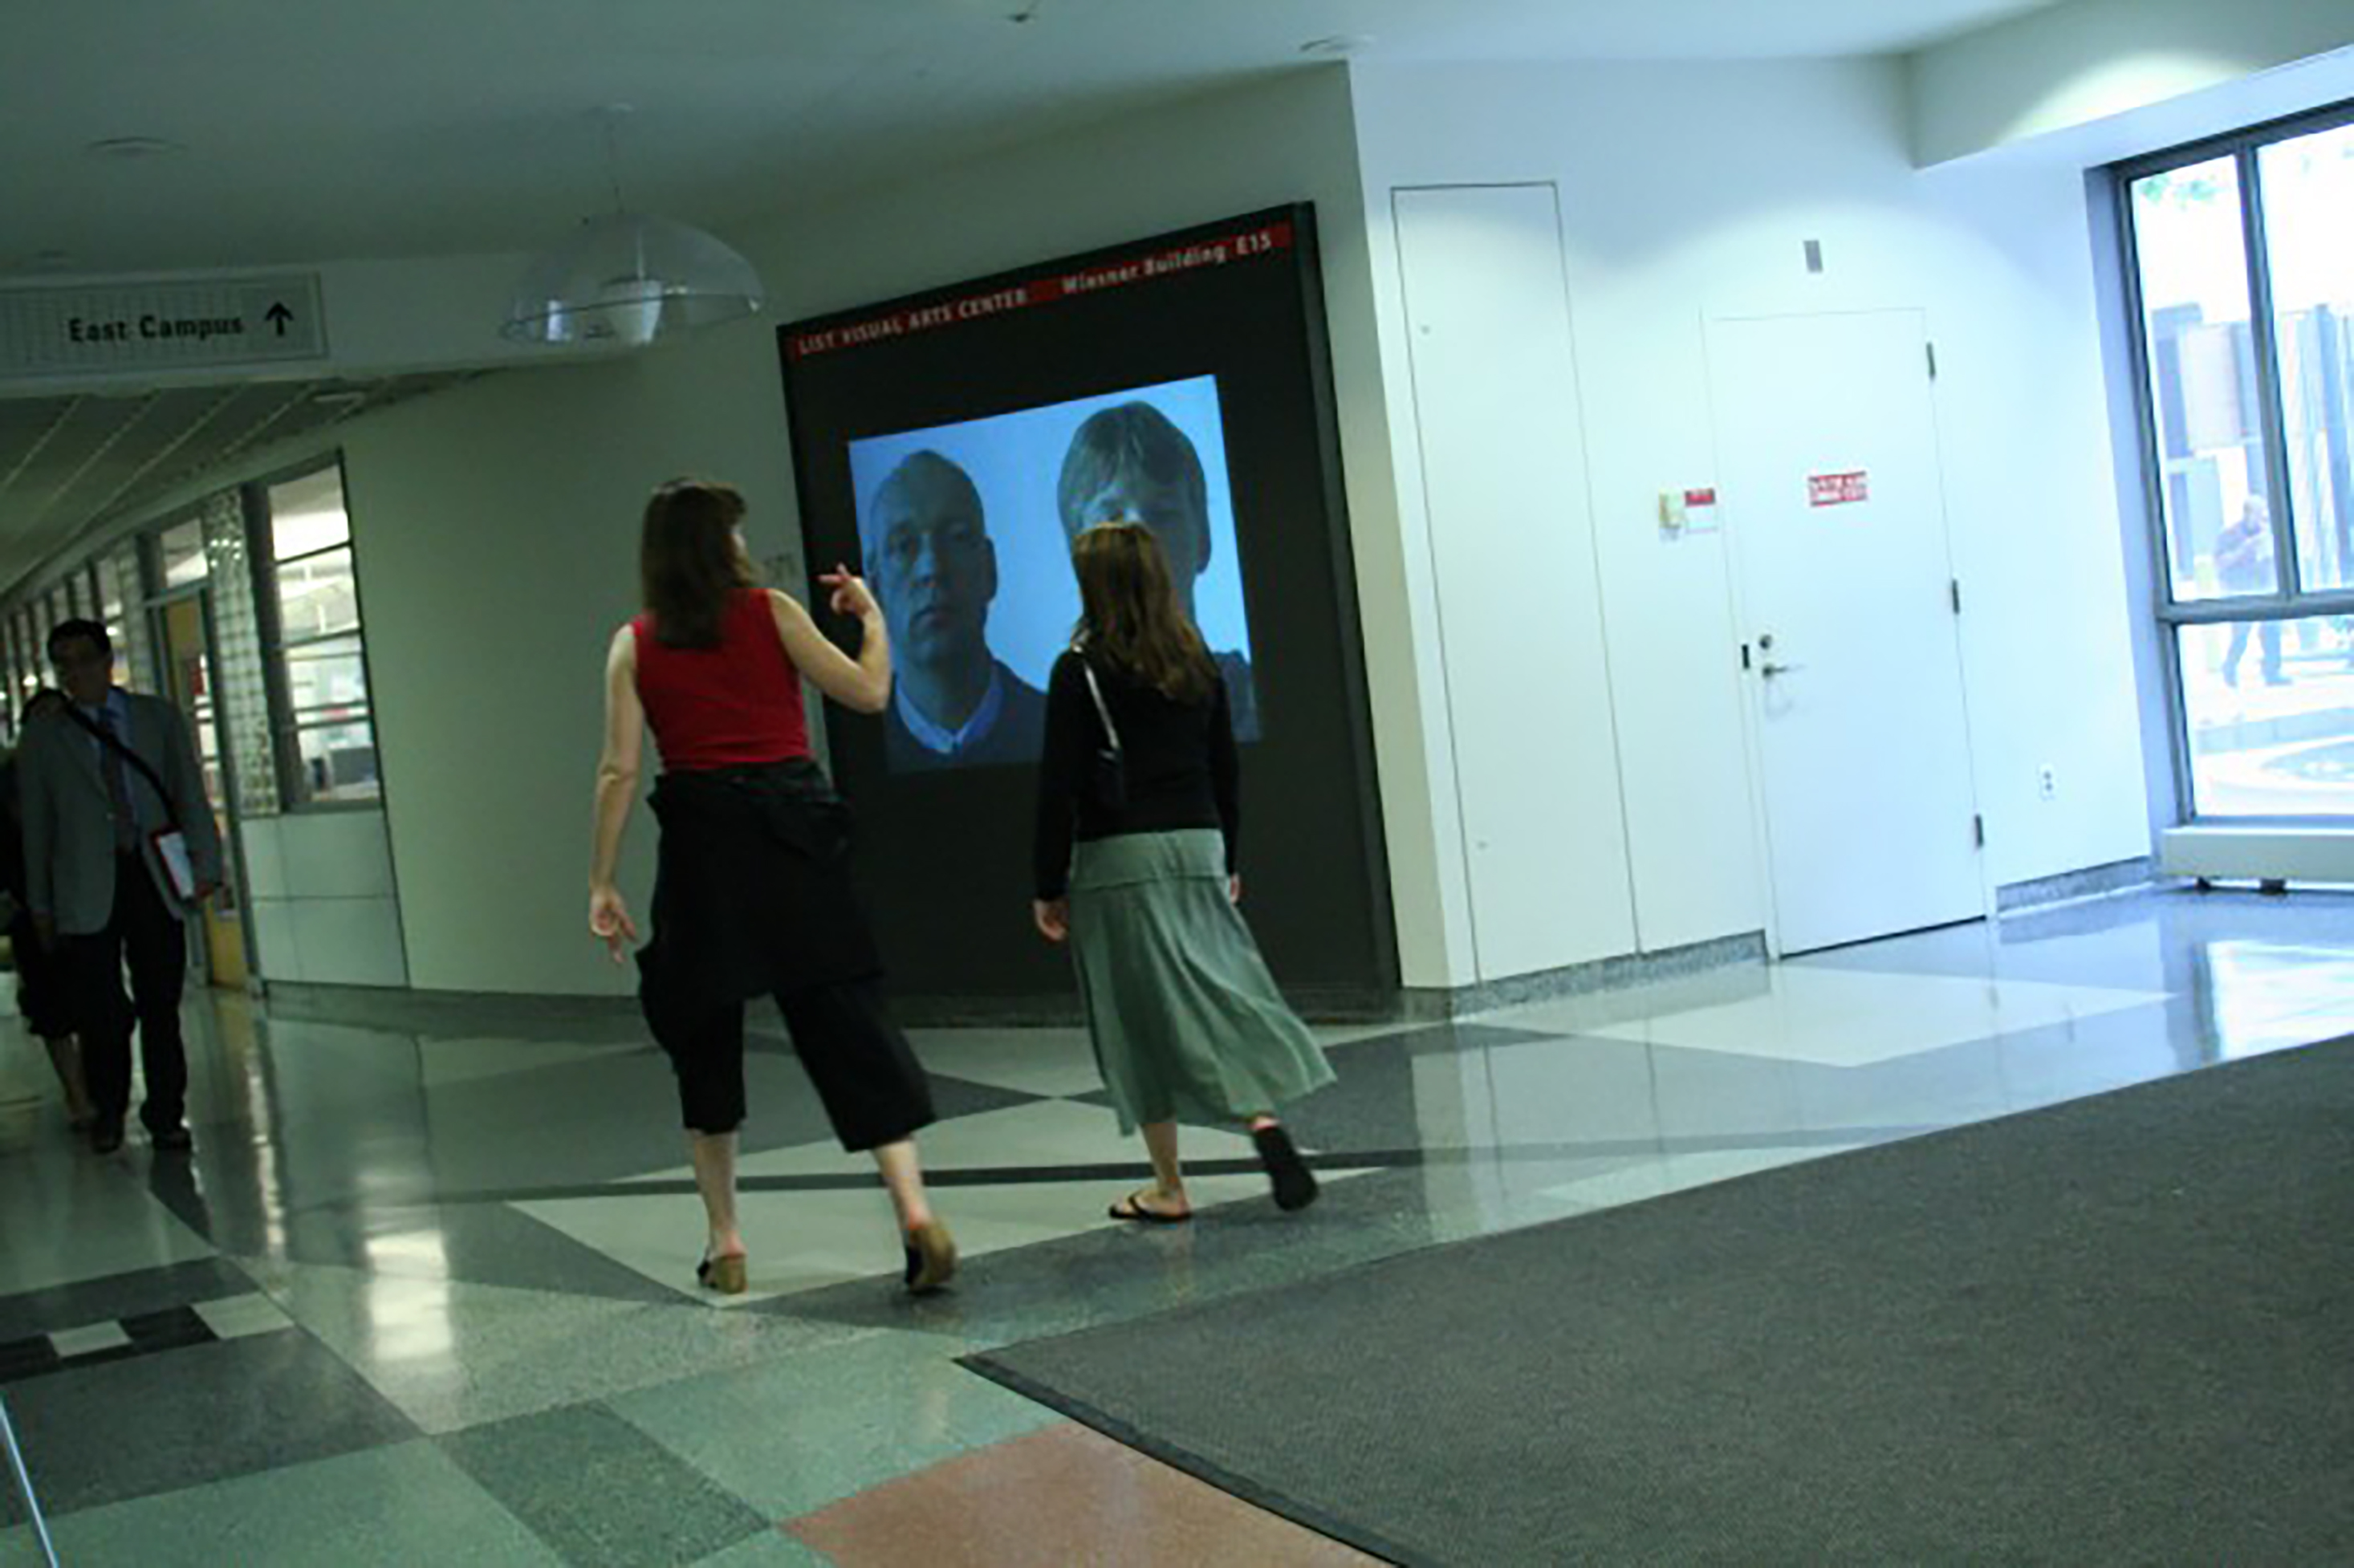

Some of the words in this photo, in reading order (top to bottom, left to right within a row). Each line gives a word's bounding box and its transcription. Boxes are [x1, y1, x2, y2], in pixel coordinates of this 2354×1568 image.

[68, 318, 125, 342] East
[140, 315, 242, 340] Campus
[799, 331, 835, 354] LIST
[844, 317, 904, 343] VISUAL
[909, 306, 952, 330] ARTS
[958, 289, 1026, 318] CENTER
[1143, 246, 1226, 275] Building
[1236, 232, 1271, 255] E15
